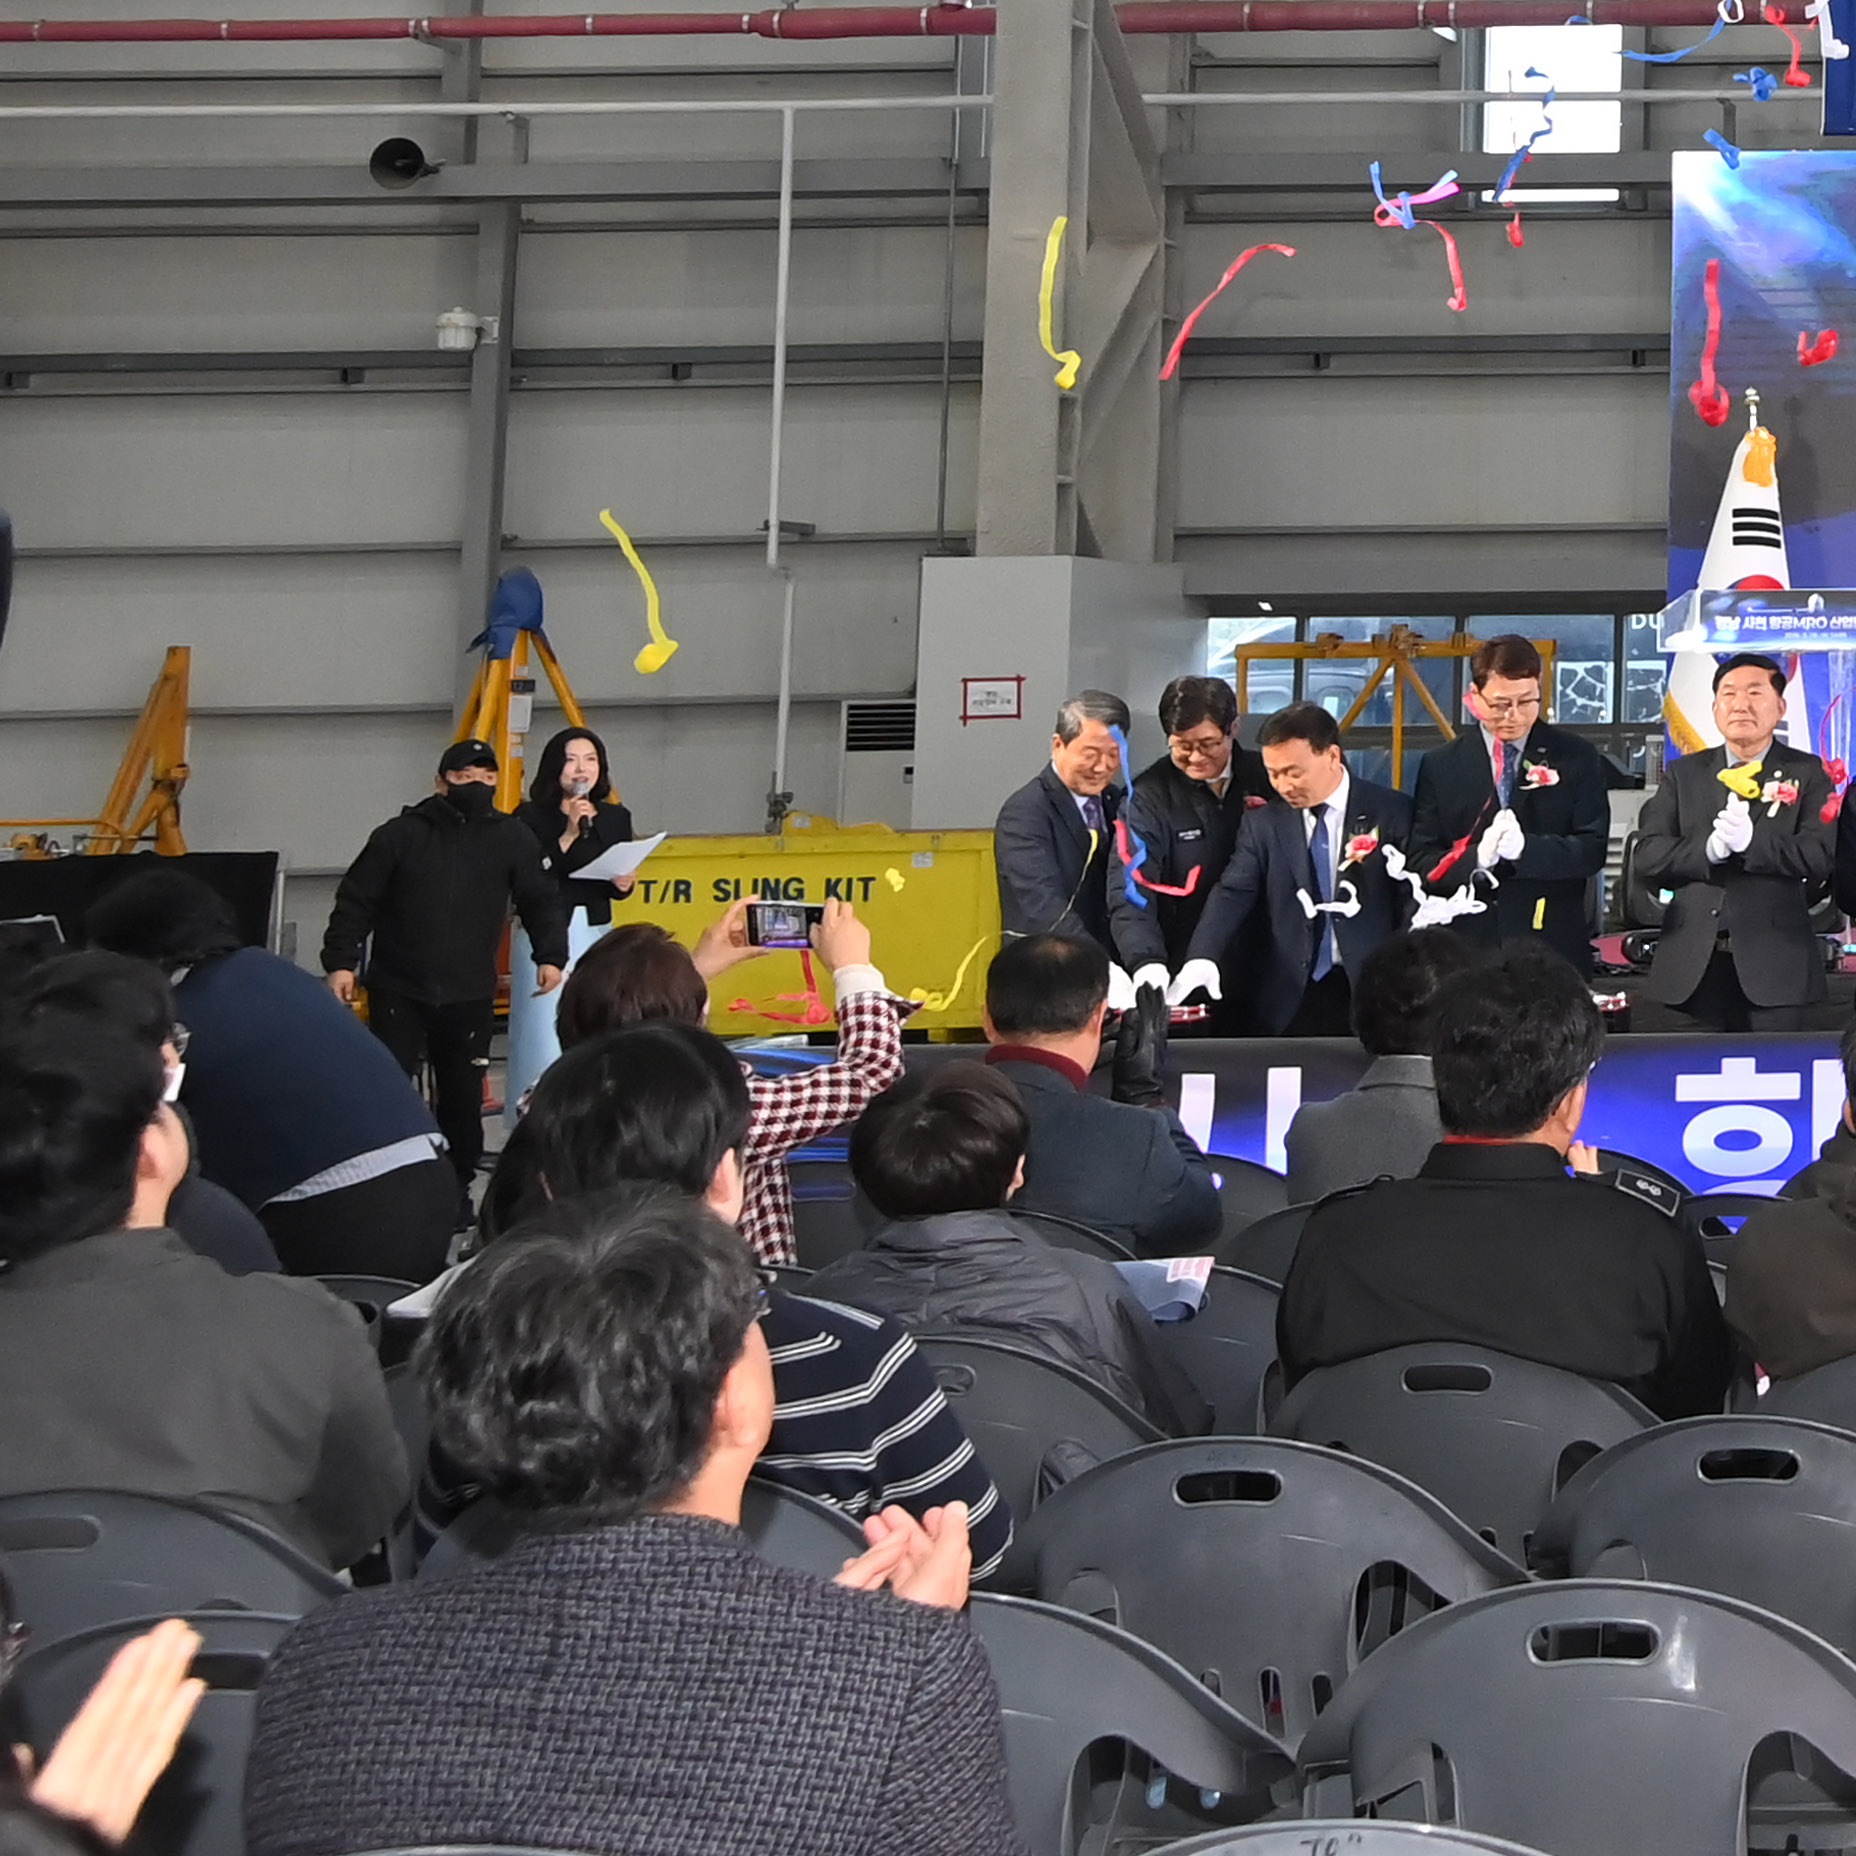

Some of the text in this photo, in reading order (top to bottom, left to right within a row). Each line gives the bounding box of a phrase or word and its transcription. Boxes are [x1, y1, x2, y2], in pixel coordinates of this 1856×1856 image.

[638, 876, 876, 904] T/R SLING KIT
